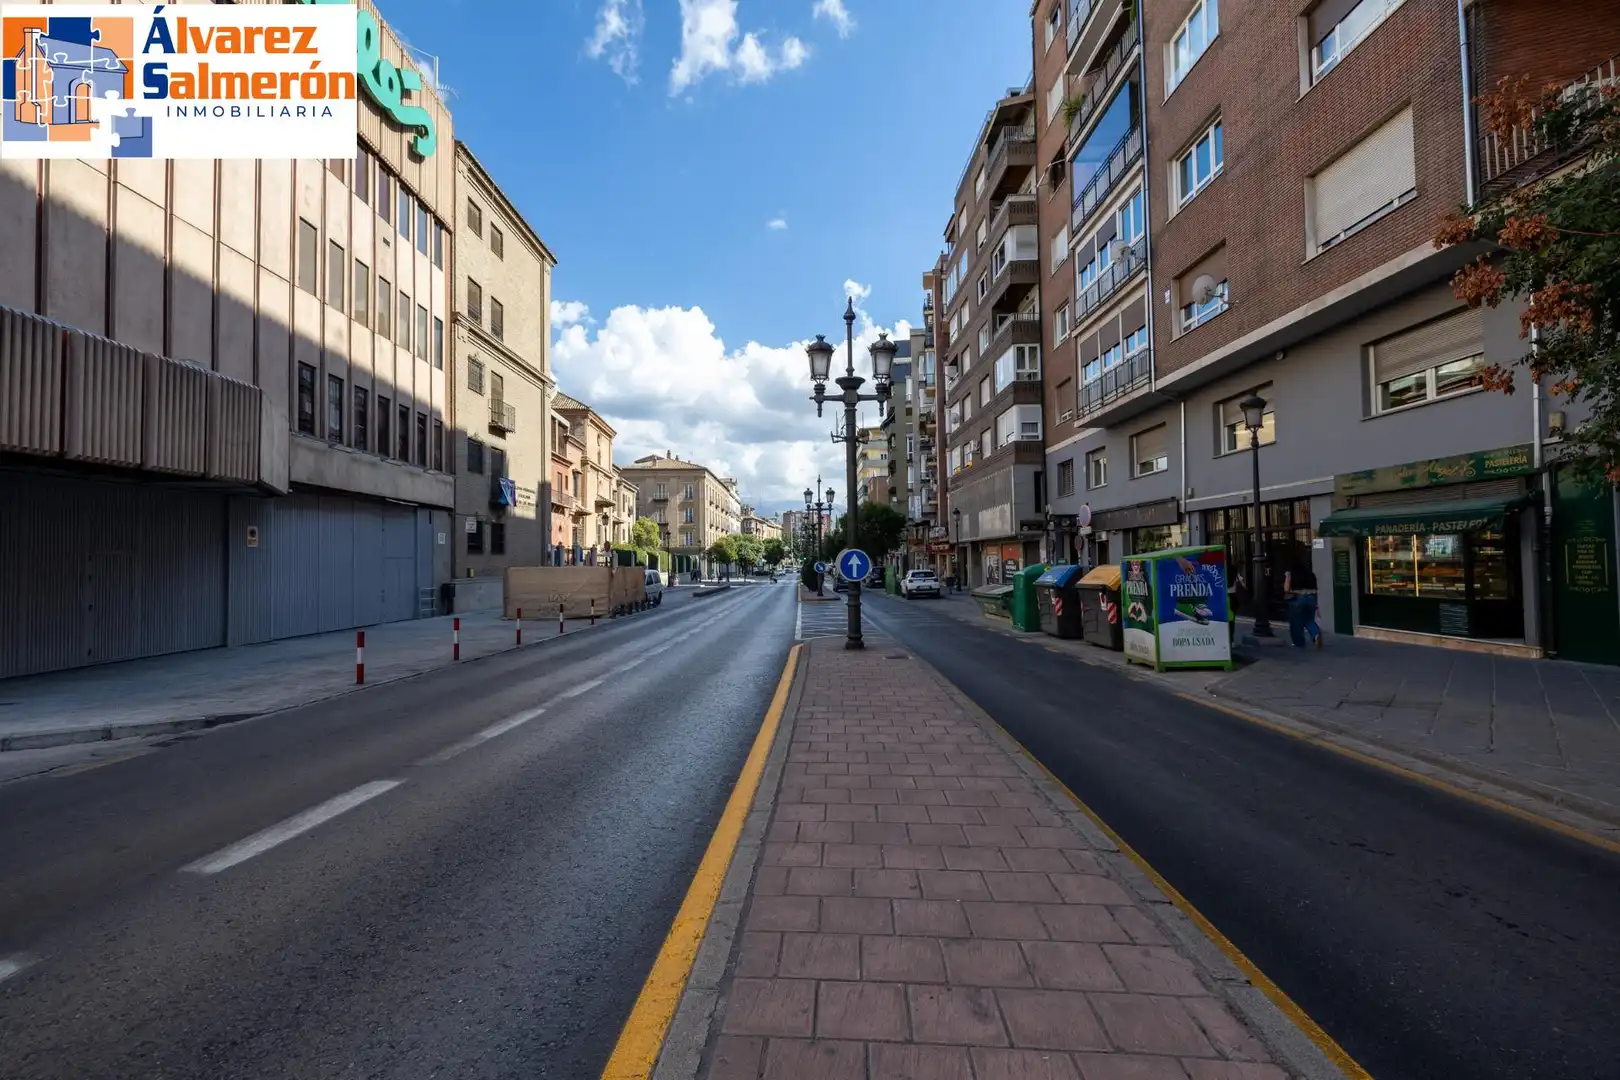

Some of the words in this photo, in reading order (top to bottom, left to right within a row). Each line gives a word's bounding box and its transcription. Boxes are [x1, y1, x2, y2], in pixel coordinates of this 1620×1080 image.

[1485, 455, 1527, 468] PASTELERÍA
[1375, 521, 1426, 534] PANADERÍA
[1126, 581, 1148, 597] PRENDA
[1169, 583, 1213, 597] PRENDA
